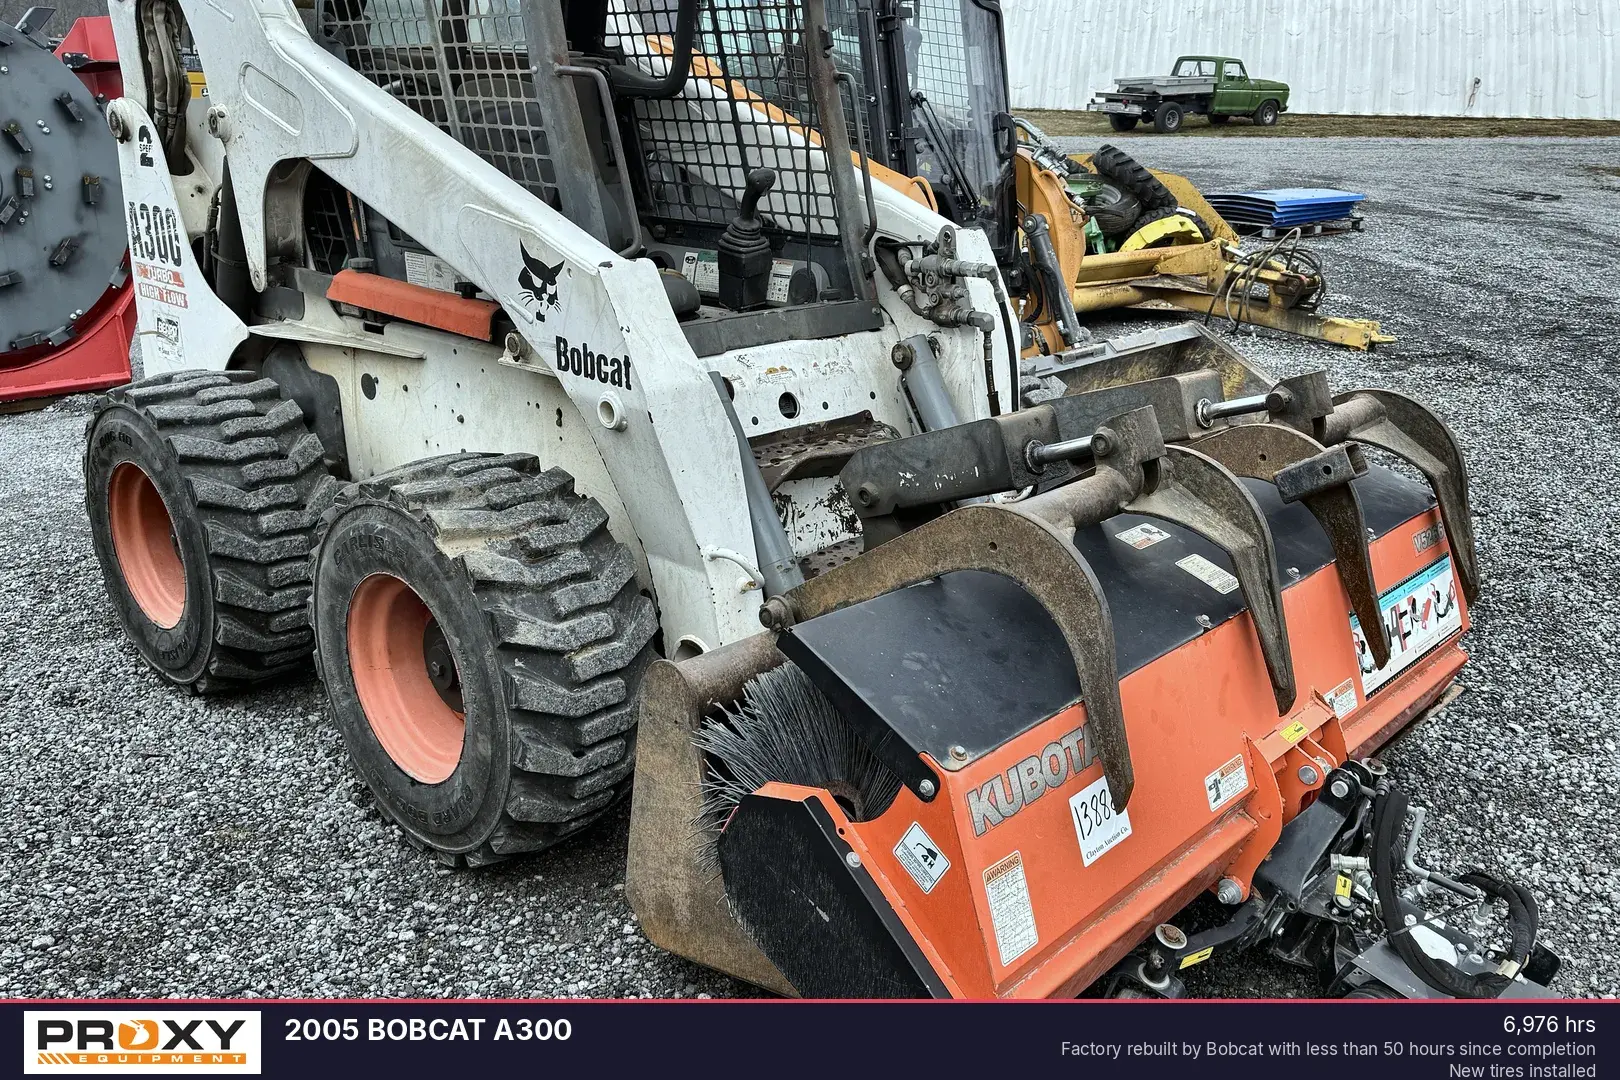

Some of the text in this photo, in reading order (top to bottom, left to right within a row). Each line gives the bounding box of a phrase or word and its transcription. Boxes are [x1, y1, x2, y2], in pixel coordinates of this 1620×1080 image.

[128, 201, 182, 267] A300
[146, 264, 174, 284] TURBO
[141, 283, 185, 307] HIGH FLOW
[555, 335, 632, 391] Bobcat
[966, 721, 1101, 837] KUBOTA
[1086, 844, 1105, 860] Clayton
[1105, 831, 1121, 848] Auction
[988, 855, 1020, 879] WARNING
